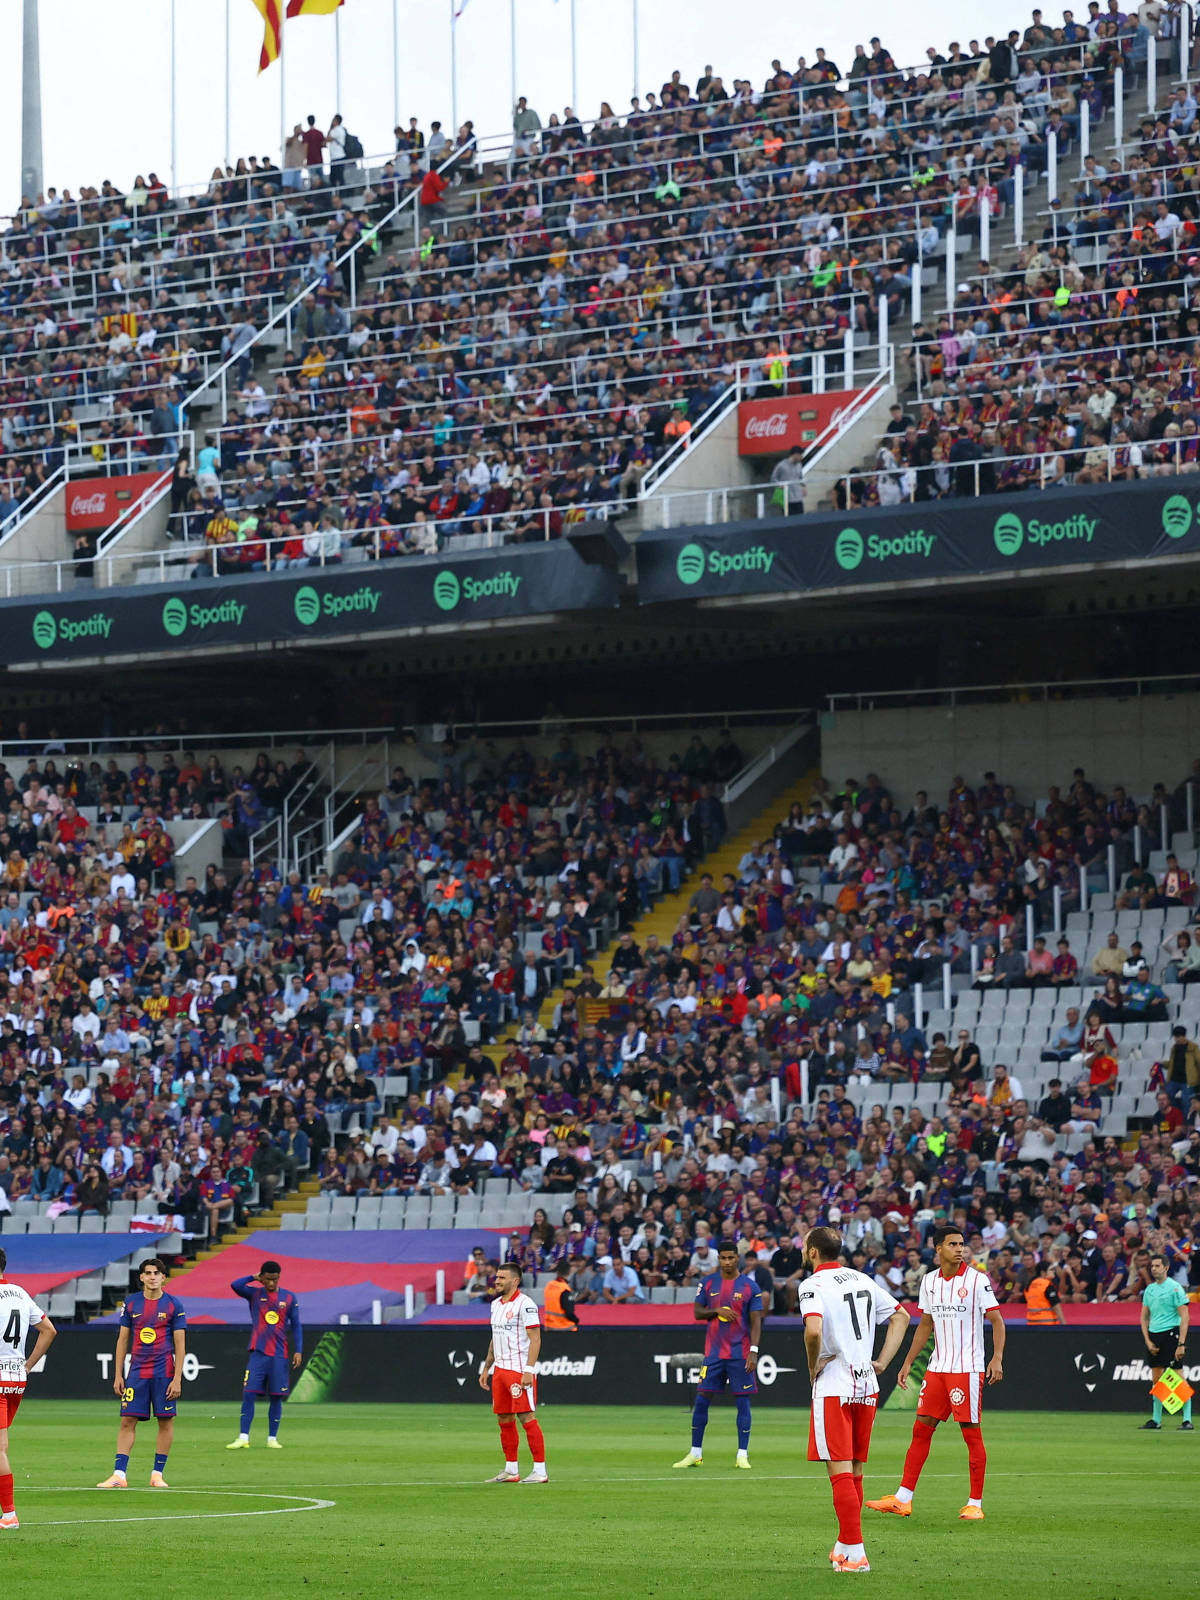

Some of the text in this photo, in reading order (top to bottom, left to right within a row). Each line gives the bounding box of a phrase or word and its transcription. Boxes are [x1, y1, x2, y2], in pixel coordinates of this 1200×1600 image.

[1027, 513, 1096, 546] Spotify
[868, 530, 934, 561] Spotify
[708, 546, 774, 576] Spotify
[463, 571, 520, 602] Spotify
[190, 599, 246, 628] Spotify
[323, 587, 381, 617] Spotify
[59, 613, 112, 641] Spotify
[843, 1290, 873, 1340] 17
[931, 1305, 967, 1313] ETIHAD
[3, 1309, 21, 1349] 4
